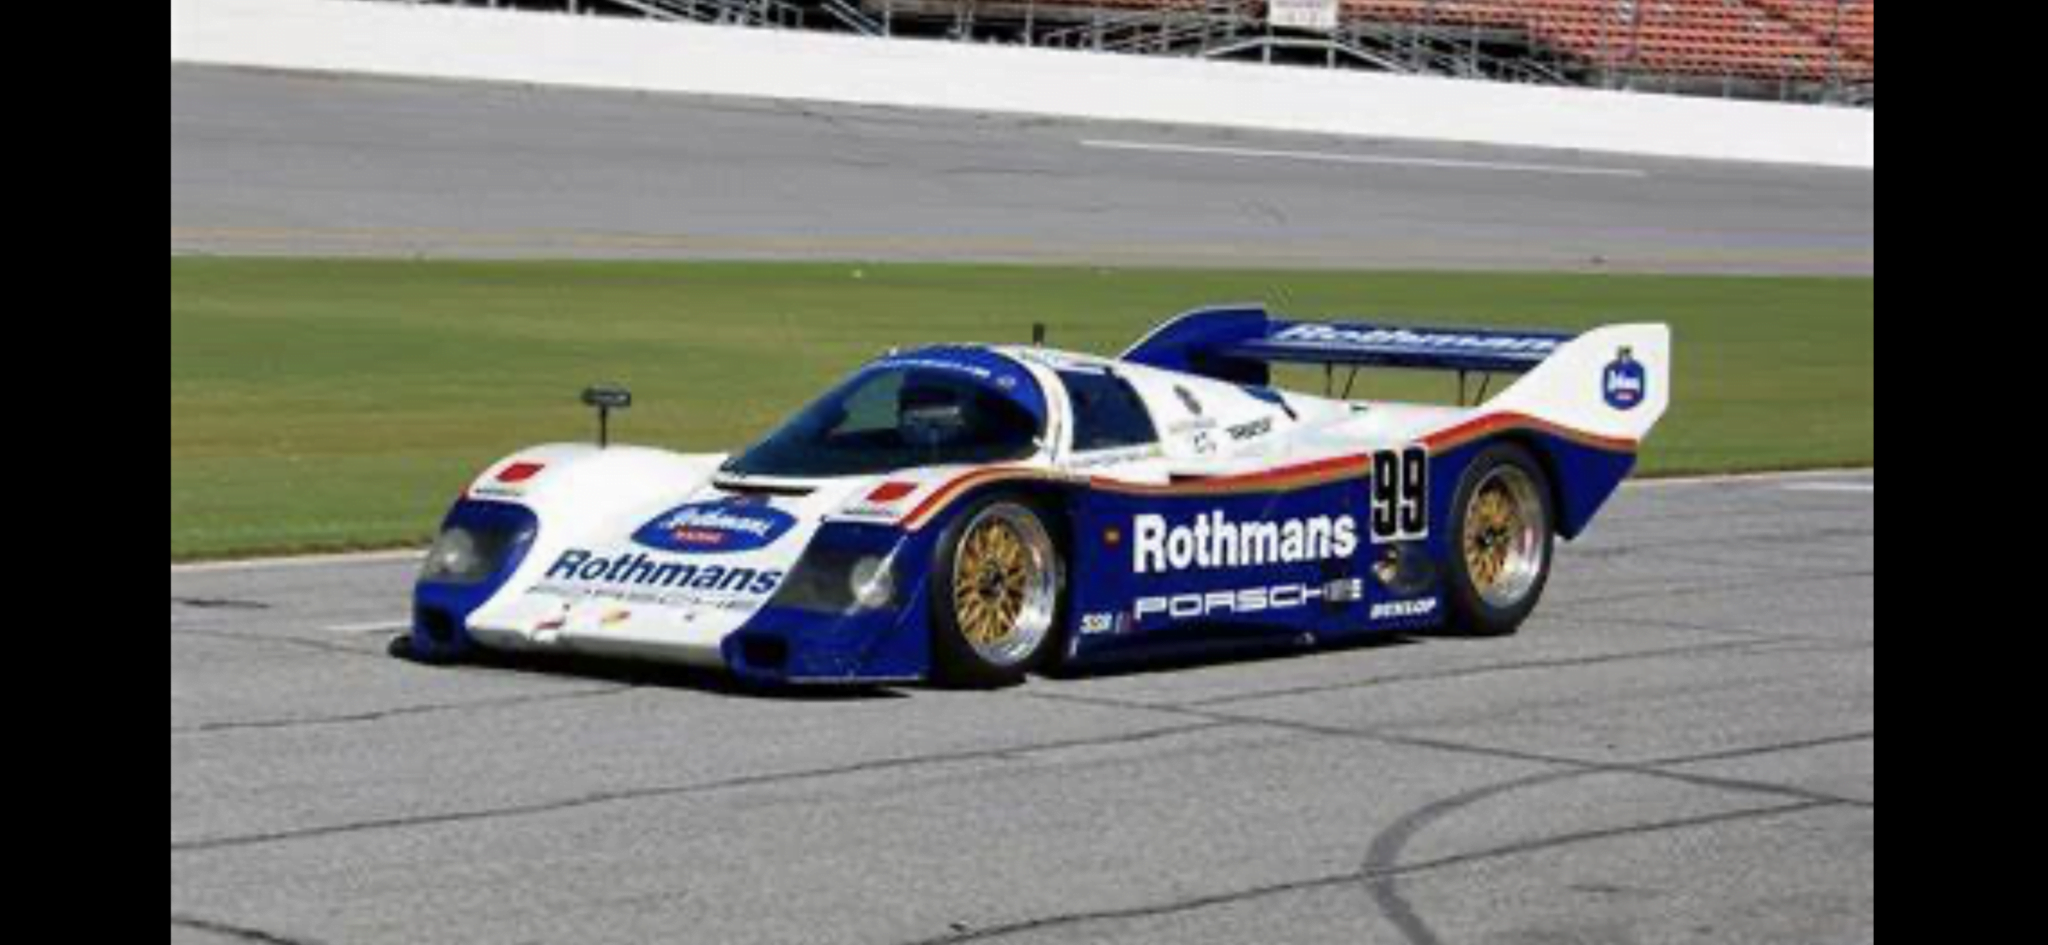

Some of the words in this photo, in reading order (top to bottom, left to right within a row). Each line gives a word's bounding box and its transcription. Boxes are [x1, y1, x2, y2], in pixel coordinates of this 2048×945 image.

[1371, 448, 1427, 538] 99
[1132, 511, 1358, 573] Rothmans
[545, 549, 784, 594] Rothmans
[1370, 597, 1436, 620] DUNLOP
